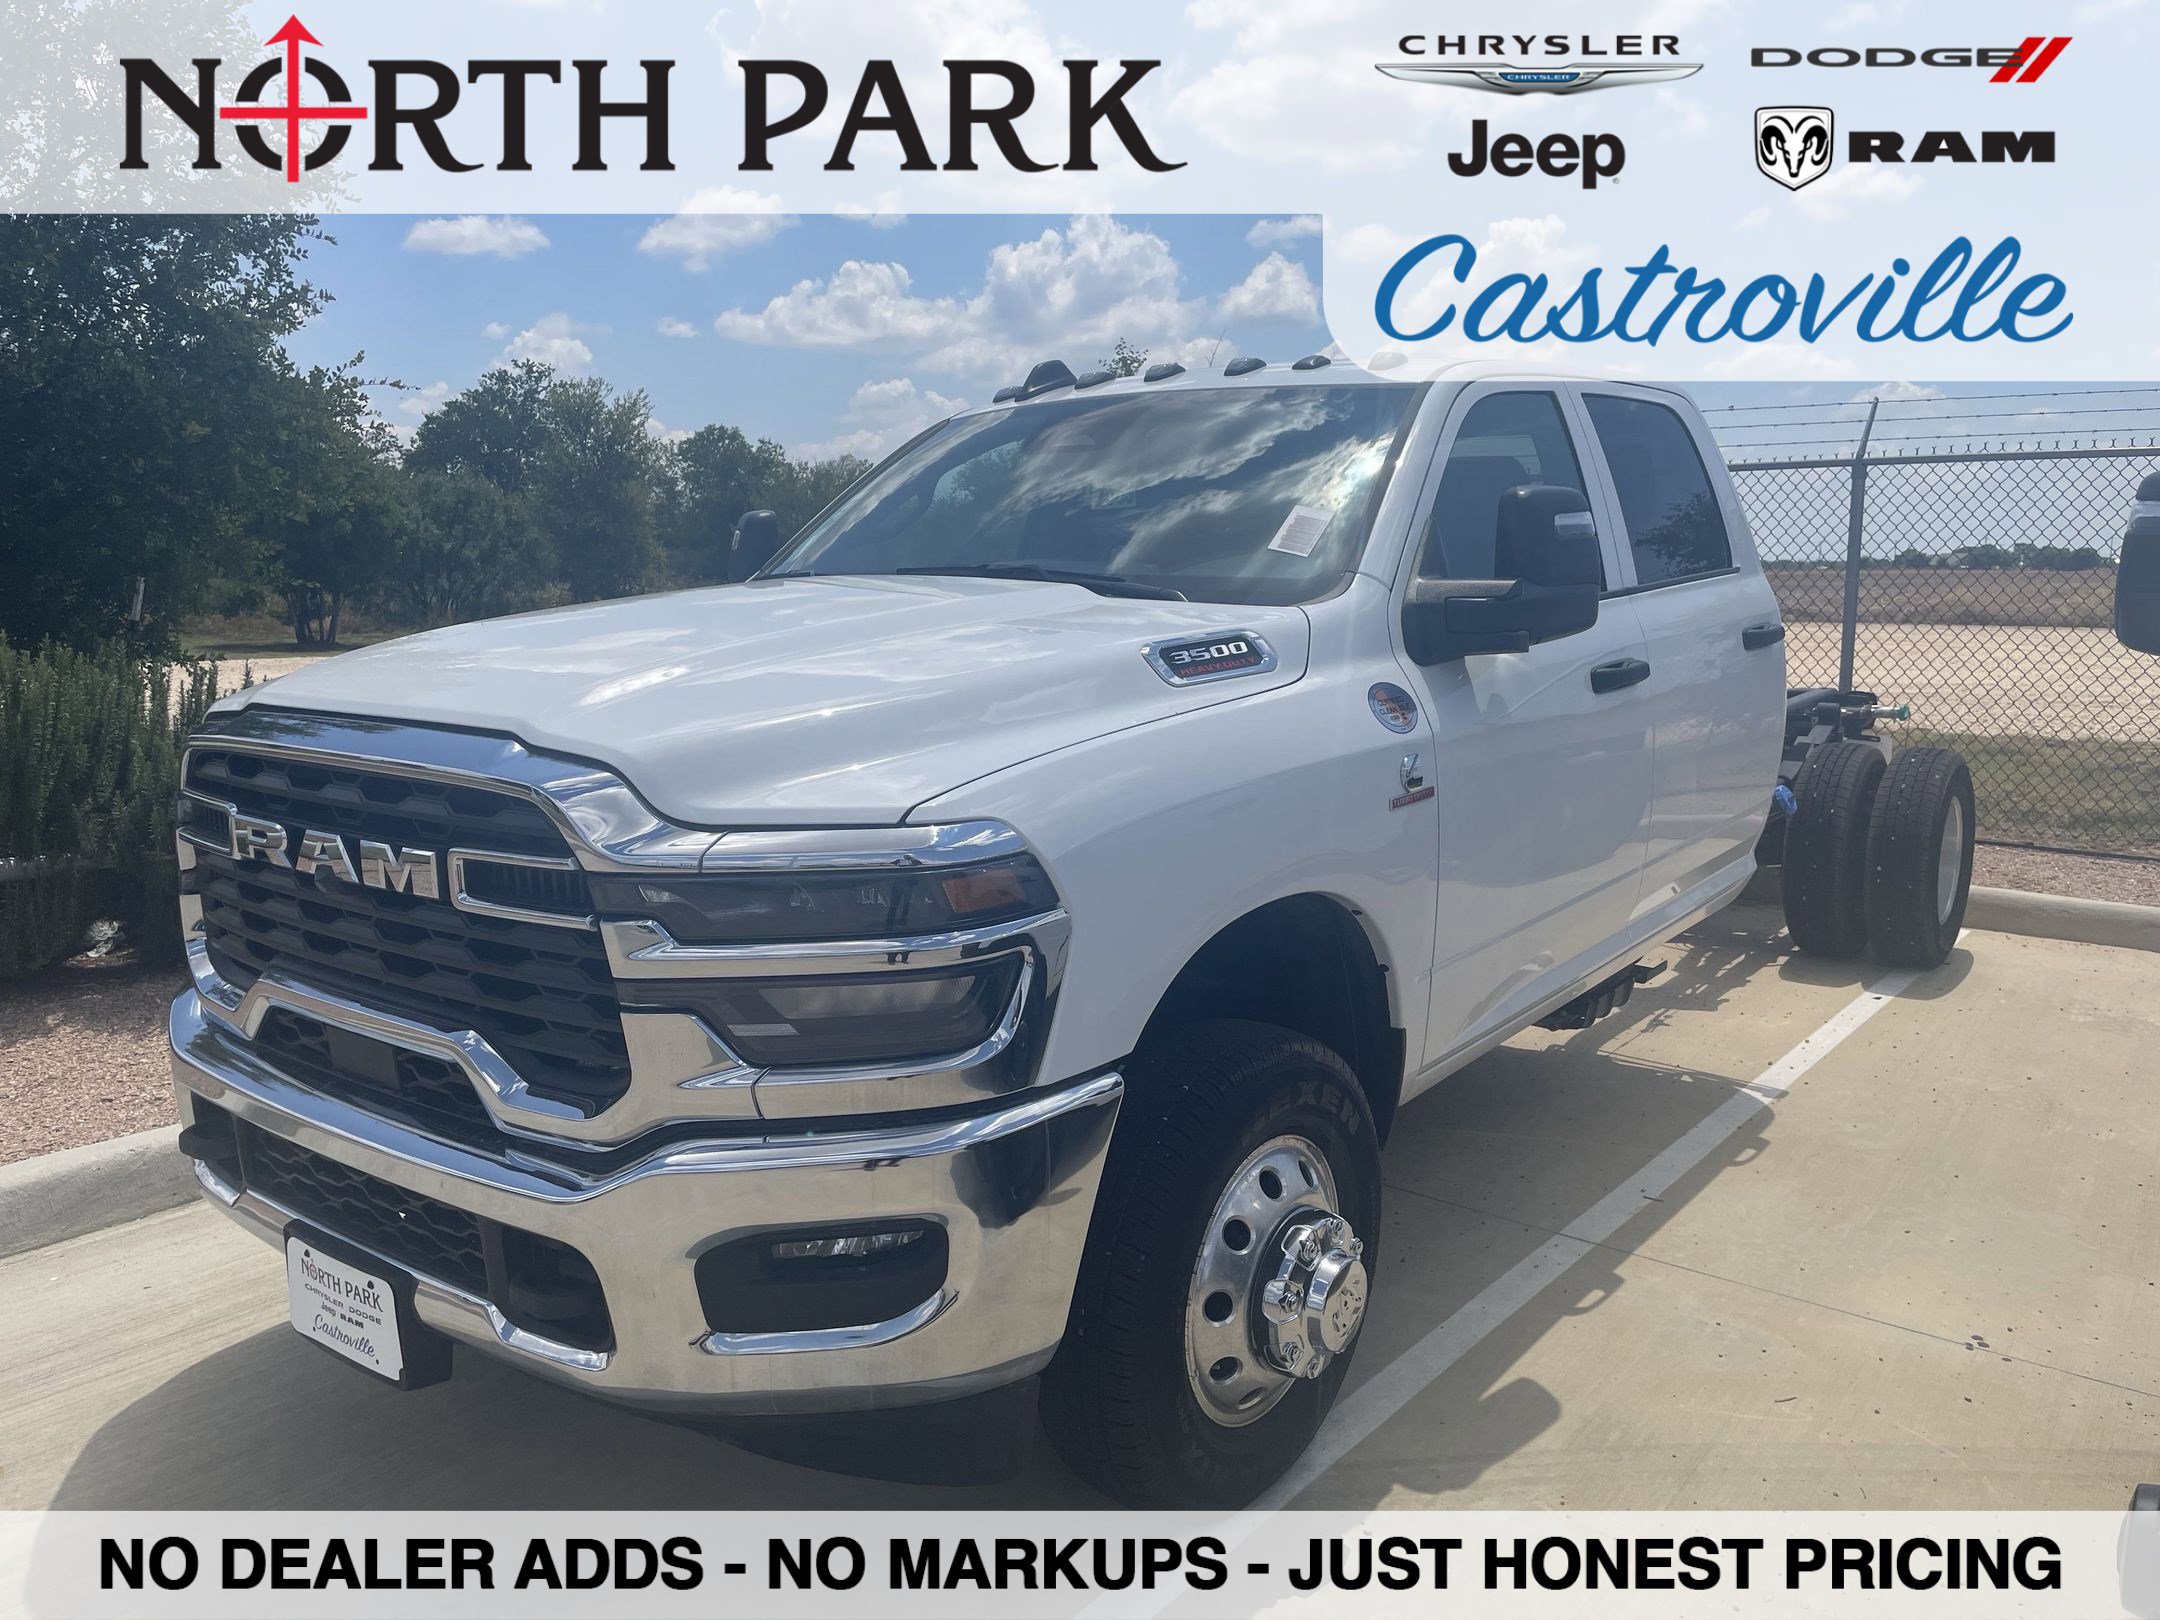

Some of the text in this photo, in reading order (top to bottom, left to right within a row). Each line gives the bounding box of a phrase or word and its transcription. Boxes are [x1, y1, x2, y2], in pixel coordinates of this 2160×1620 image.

[1169, 641, 1249, 664] 3500
[1180, 656, 1255, 676] HEAVY DUTY
[232, 814, 440, 900] RAM
[301, 1257, 384, 1313] NORTH PARK
[304, 1283, 383, 1326] CHRYSLER DODGE
[314, 1313, 375, 1357] Castroville
[340, 1313, 364, 1329] RAM
